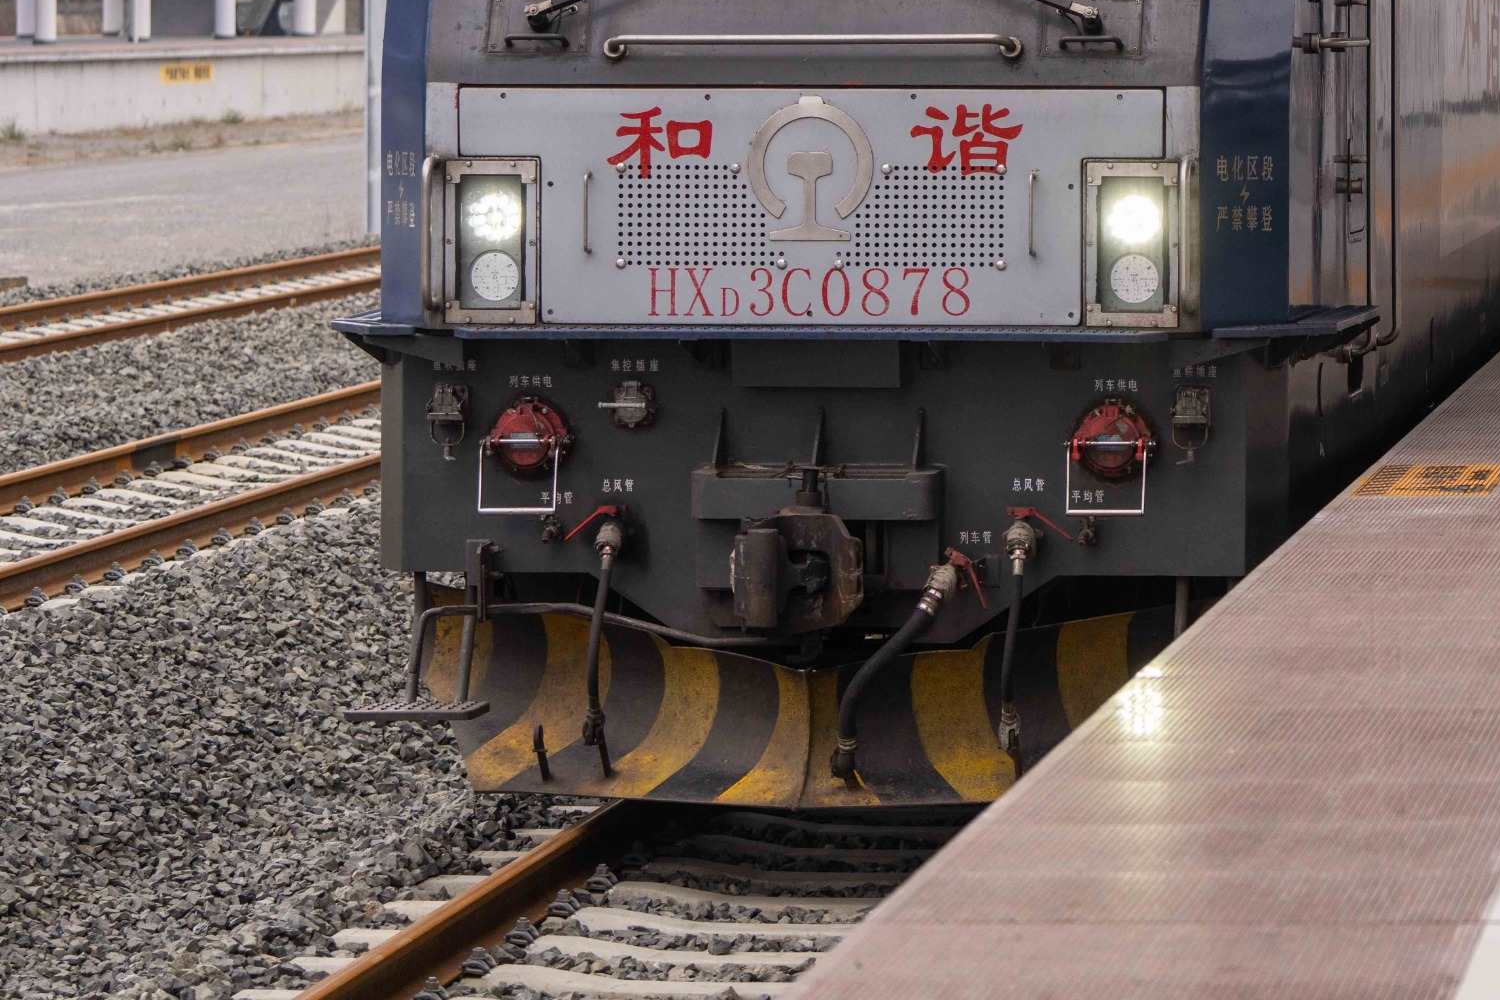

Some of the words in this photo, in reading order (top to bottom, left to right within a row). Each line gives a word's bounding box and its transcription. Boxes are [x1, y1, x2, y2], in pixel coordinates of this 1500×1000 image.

[607, 106, 713, 179] 和
[911, 103, 1023, 175] 谐
[1217, 155, 1274, 181] 电化区段
[1216, 205, 1273, 232] 严禁攀登
[647, 267, 971, 318] HXD3C0878
[611, 358, 660, 372] 集控插座
[508, 375, 553, 388] 列车供电
[1093, 379, 1138, 392] 列车供电
[602, 479, 634, 493] 总风管
[1012, 478, 1045, 492] 总风管
[1071, 490, 1105, 503] 平均管
[959, 531, 992, 545] 列车管
